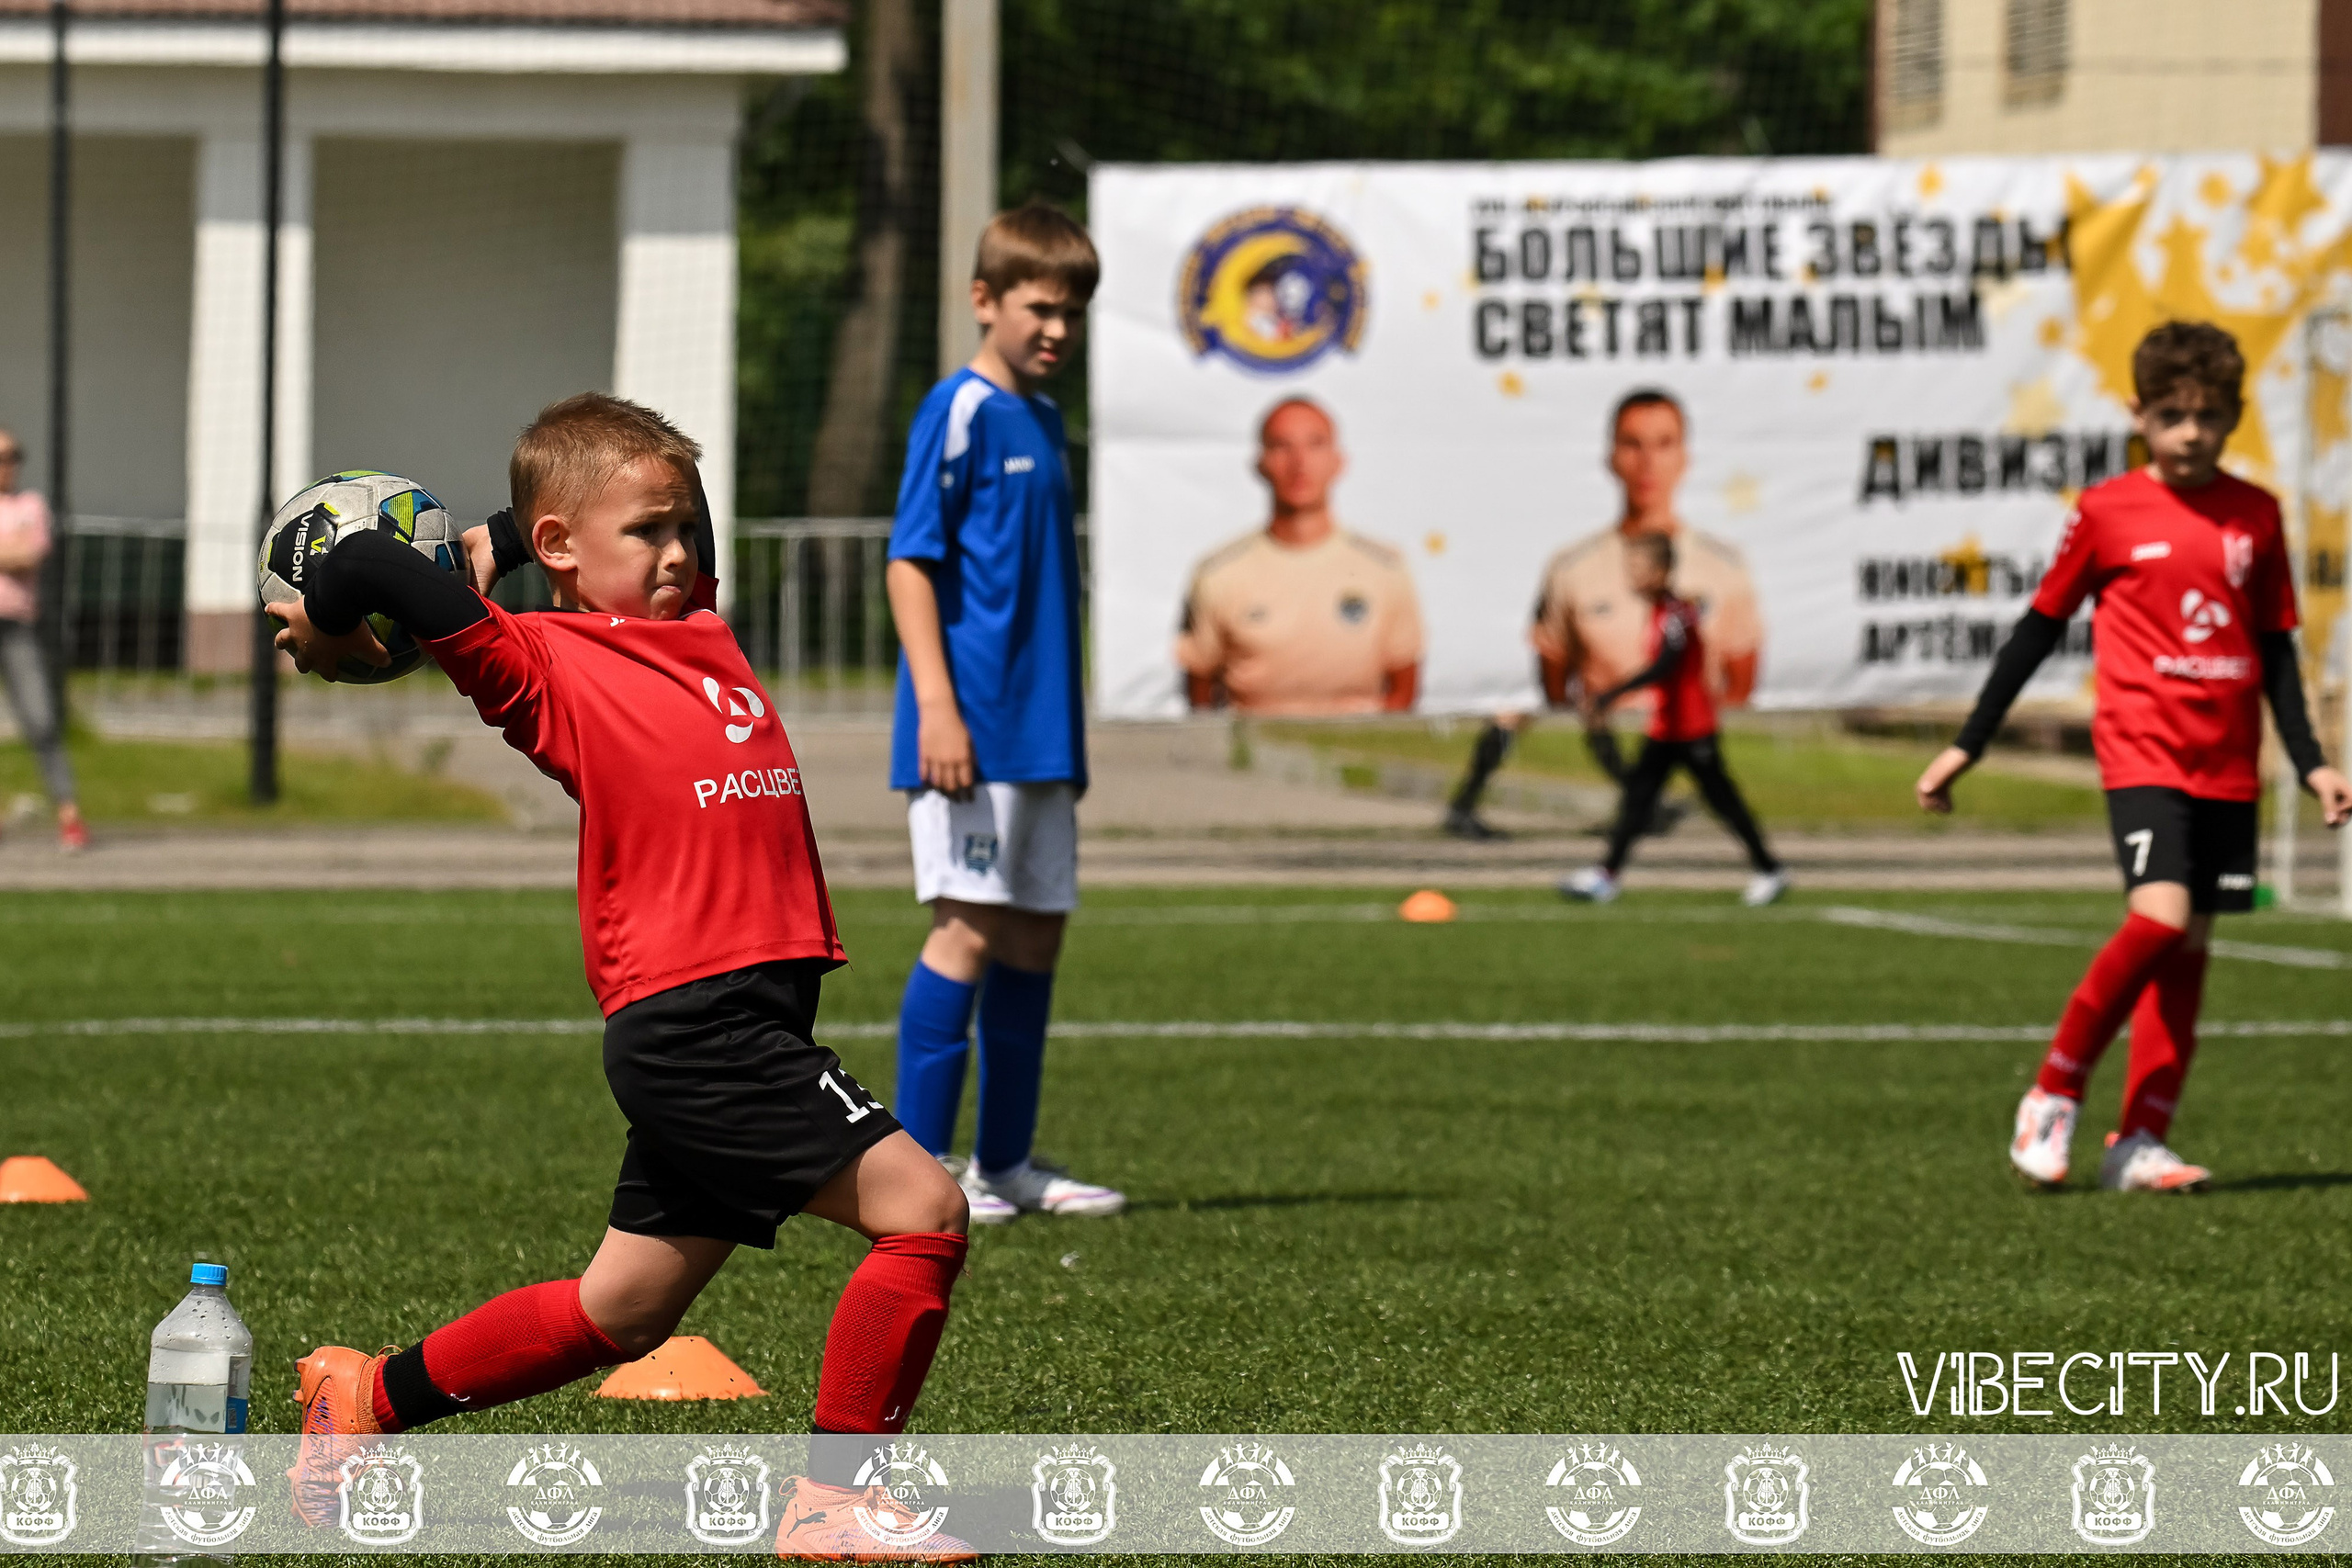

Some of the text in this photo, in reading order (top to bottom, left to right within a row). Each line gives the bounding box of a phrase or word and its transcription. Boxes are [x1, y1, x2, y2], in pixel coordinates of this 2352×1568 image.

[1475, 211, 2073, 283] БОЛЬШИЕ ЗВЁЗДЫ
[1474, 290, 1988, 360] СВЕТЯТ МАЛЫМ
[292, 513, 314, 582] VISION
[693, 767, 802, 808] РАСЦВЕ
[2123, 829, 2154, 877] 7
